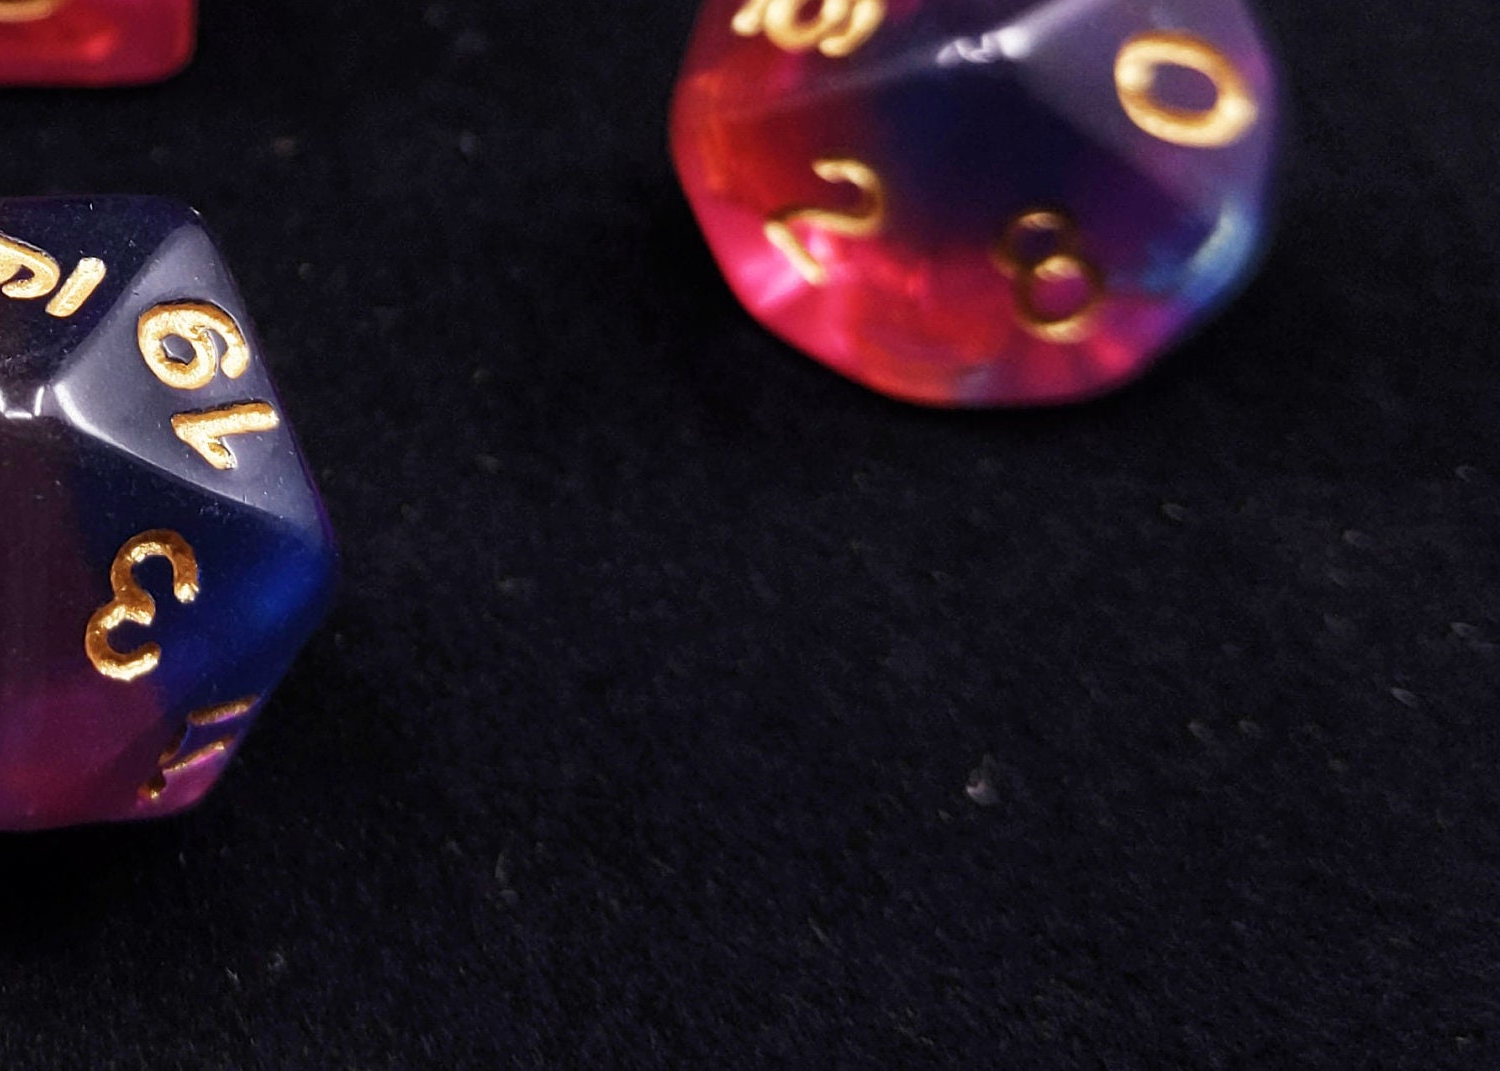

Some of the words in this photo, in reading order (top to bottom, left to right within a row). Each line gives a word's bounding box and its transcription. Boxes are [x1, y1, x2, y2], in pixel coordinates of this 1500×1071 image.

[1113, 32, 1256, 148] 0
[766, 159, 883, 284] 2
[998, 210, 1104, 343] 8
[86, 530, 199, 681] 3
